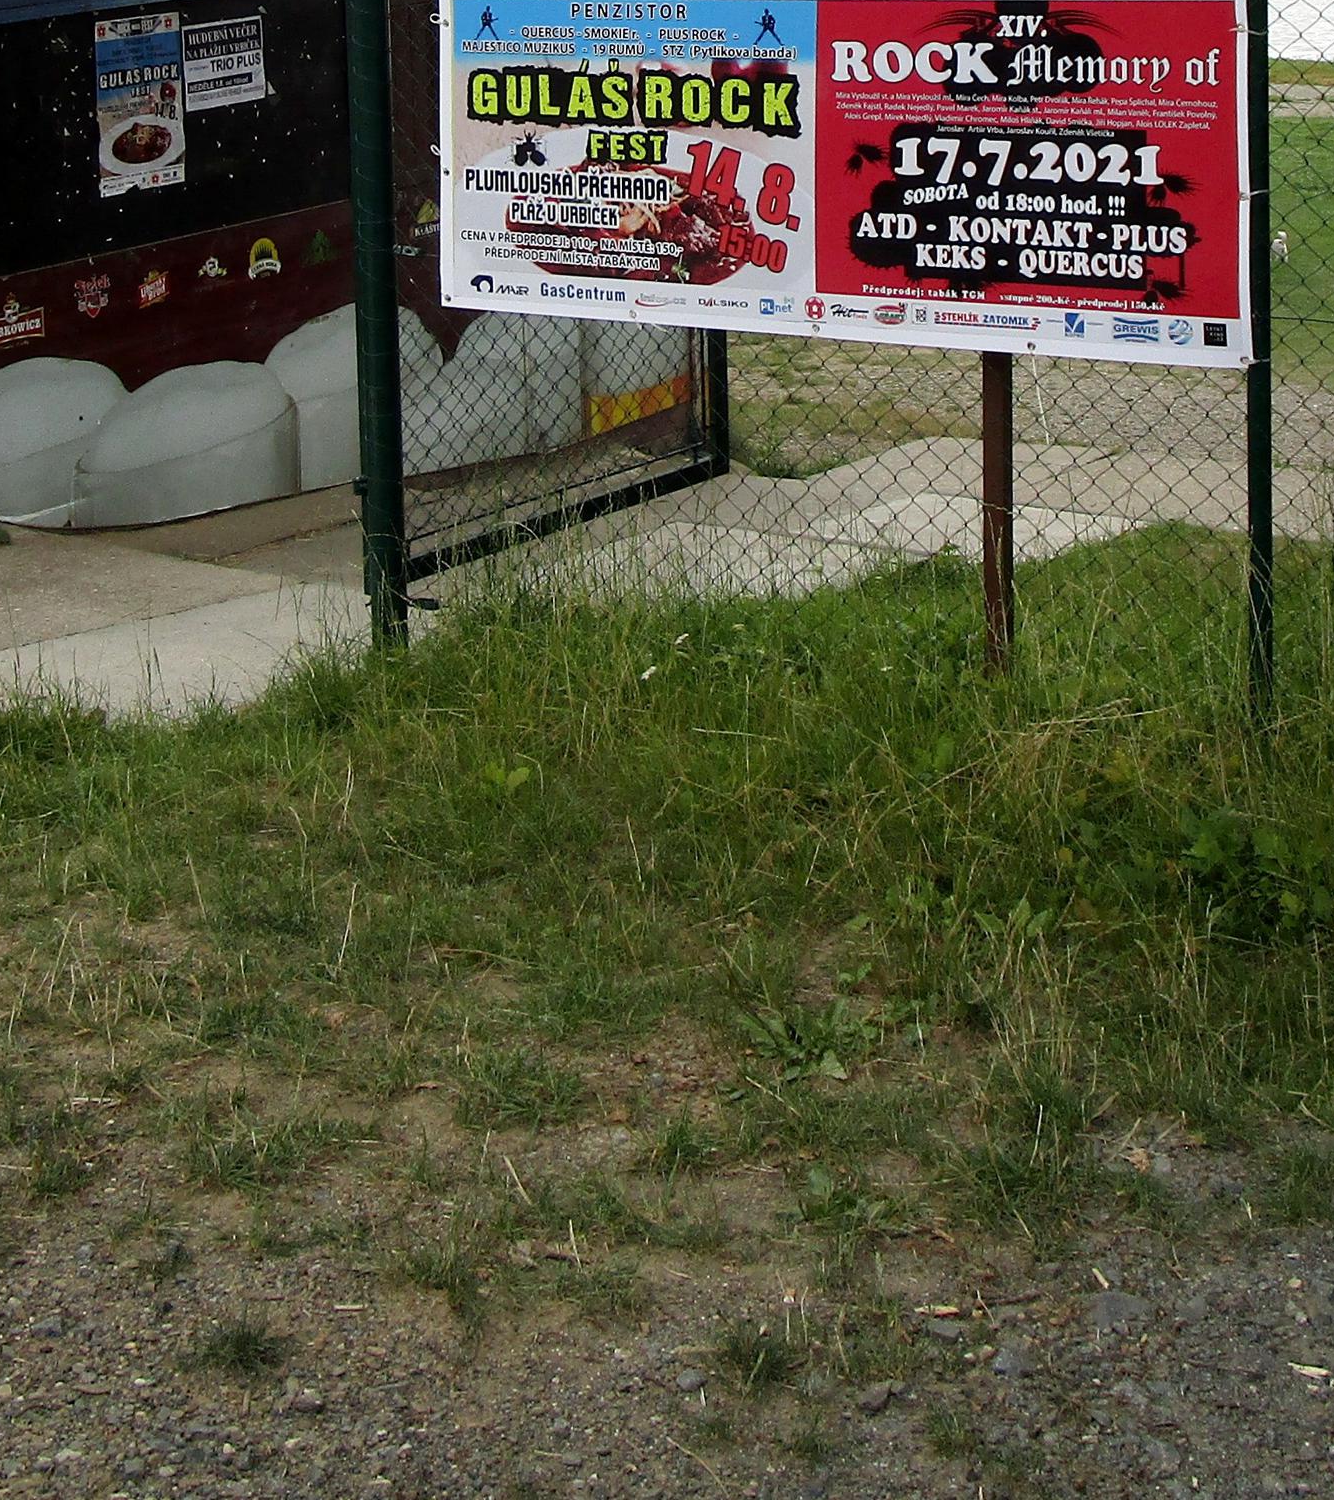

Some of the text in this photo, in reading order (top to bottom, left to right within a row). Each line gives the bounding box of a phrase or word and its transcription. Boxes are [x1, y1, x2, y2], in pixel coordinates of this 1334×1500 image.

[571, 3, 688, 20] PENZISTOR
[521, 27, 574, 40] QUERCUS
[584, 27, 630, 40] SMOKIE
[659, 29, 689, 41] PLUS
[692, 29, 726, 41] ROCK
[995, 14, 1047, 37] XIV.
[462, 40, 521, 53] MAJESTICO
[524, 42, 576, 54] MUZIKUS
[593, 43, 606, 55] 19
[662, 45, 684, 57] STZ
[752, 45, 798, 60] banda)
[143, 63, 178, 82] ROCK
[210, 57, 234, 73] TRIO
[236, 52, 262, 69] PLUS
[831, 41, 1221, 93] ROCK Memory of
[471, 58, 794, 127] GULÁŠ ROCK
[590, 133, 666, 162] FEST
[893, 136, 1165, 187] 17.7.2021
[580, 168, 669, 202] PŘEHRADA
[687, 139, 800, 231] 14. 8.
[902, 183, 969, 206] SOBOTA
[975, 192, 1000, 211] od
[1004, 193, 1056, 214] 18:00
[1060, 194, 1103, 216] hod.
[460, 230, 486, 242] CENA
[489, 232, 496, 242] V
[600, 238, 618, 250] NA
[857, 212, 1188, 255] ATD KONTAKT PLUS
[717, 223, 789, 274] 15:00
[599, 251, 635, 268] TABÁK
[635, 257, 660, 270] TGM
[915, 244, 1144, 280] KEKS QUERCUS
[540, 281, 626, 302] GasCentrum
[927, 288, 959, 300] tabák
[1113, 323, 1160, 335] GREWIS
